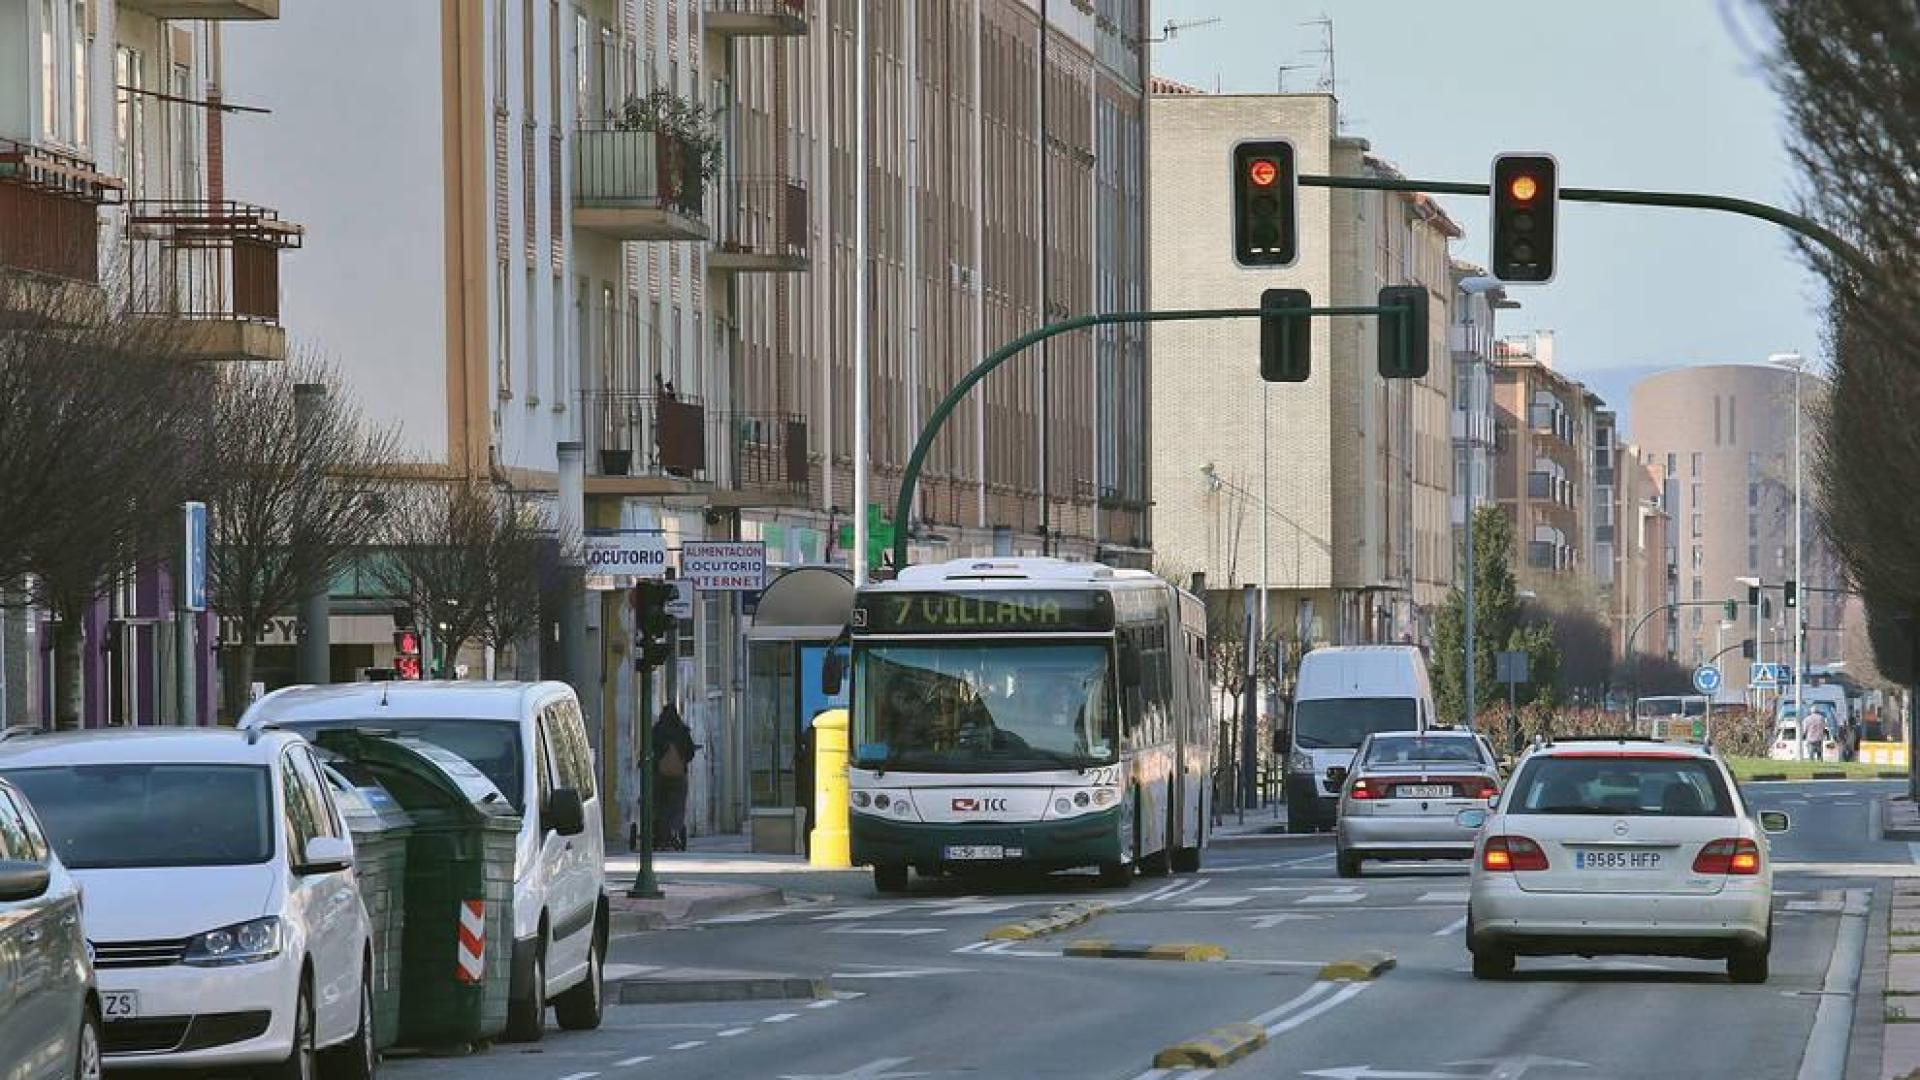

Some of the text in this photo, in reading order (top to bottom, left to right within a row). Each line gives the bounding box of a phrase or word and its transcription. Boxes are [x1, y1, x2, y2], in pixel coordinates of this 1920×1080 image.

[684, 561, 761, 572] LOCUTORIO
[692, 576, 761, 587] NTERNET
[896, 598, 909, 624] 7
[984, 798, 1007, 812] TCC
[1587, 852, 1661, 867] 9585 HFP
[105, 995, 131, 1015] ZS
